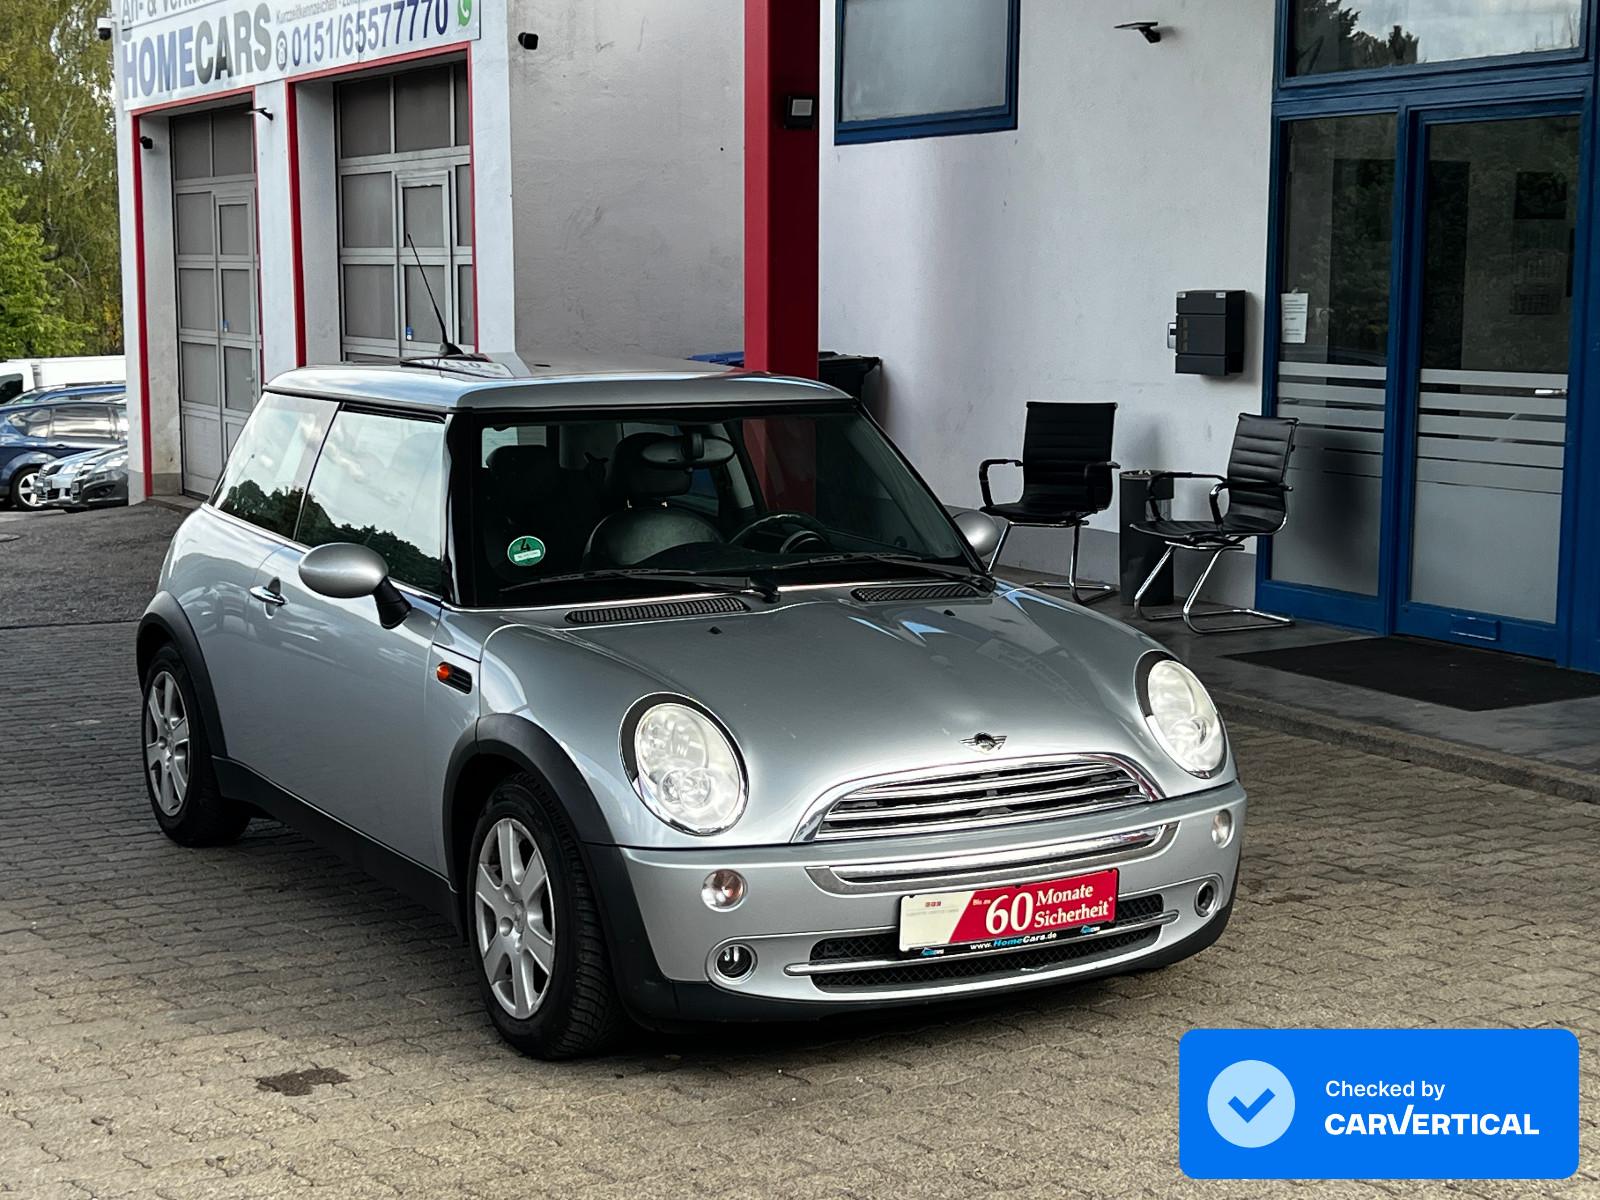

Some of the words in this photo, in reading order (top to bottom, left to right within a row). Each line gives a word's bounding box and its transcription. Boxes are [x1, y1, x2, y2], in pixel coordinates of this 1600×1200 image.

[122, 3, 271, 99] HOMECARS
[292, 0, 448, 66] 0151/65577770
[985, 892, 1034, 934] 60
[1036, 884, 1093, 906] Monate
